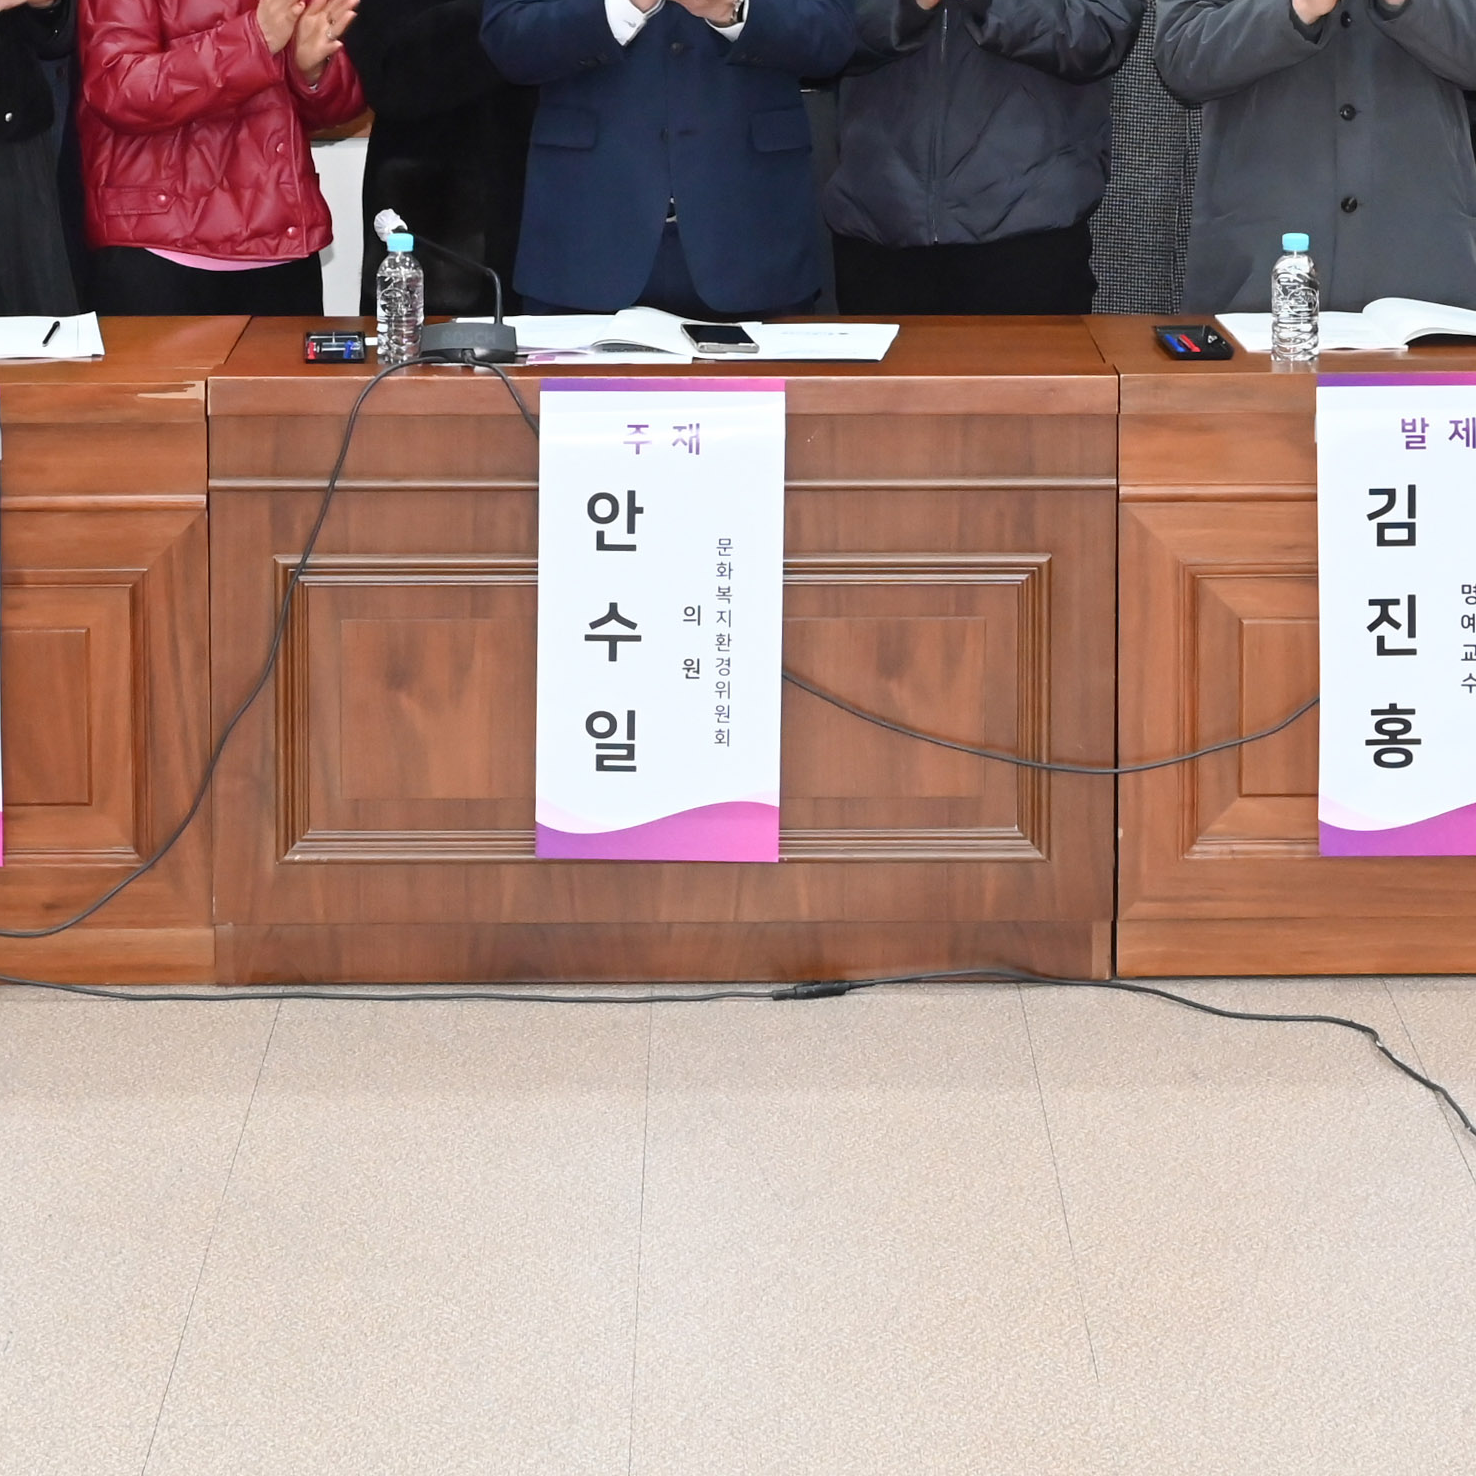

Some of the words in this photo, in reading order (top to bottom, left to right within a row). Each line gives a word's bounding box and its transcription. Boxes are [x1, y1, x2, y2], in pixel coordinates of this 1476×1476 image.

[1401, 416, 1476, 450] 발제
[583, 489, 645, 773] 안수일
[682, 604, 701, 680] 의원
[714, 538, 733, 747] 문화복지환경위원회
[1364, 483, 1422, 769] 김진홍
